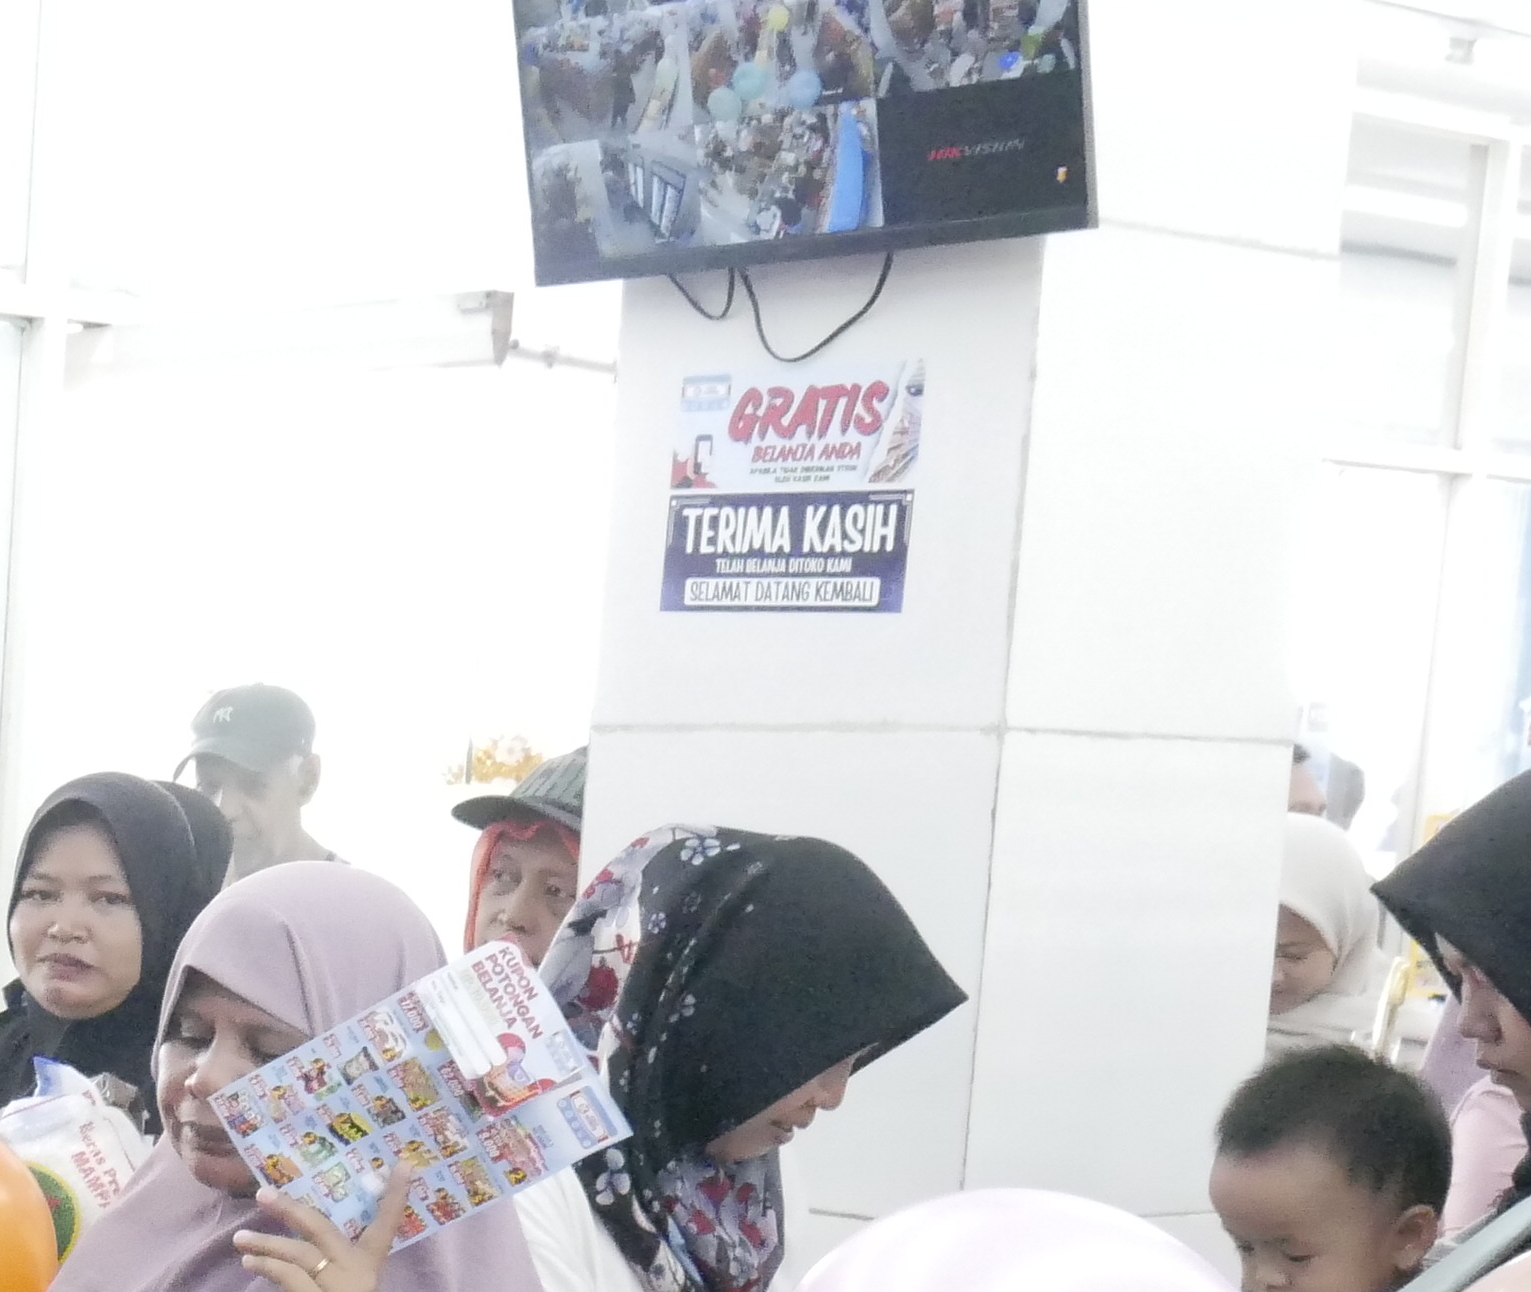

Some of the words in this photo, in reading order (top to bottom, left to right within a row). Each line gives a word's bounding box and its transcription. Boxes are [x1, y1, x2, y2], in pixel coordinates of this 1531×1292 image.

[728, 379, 890, 444] GRATIS
[751, 443, 815, 464] BELANJA
[818, 441, 862, 461] ANDA
[682, 505, 791, 554] TERIMA
[802, 503, 898, 553] KASIH
[690, 580, 750, 602] SELAMAT
[755, 580, 810, 602] DATANG
[815, 580, 874, 602] KEMBALI
[716, 558, 744, 573] TELAH
[746, 558, 786, 573] BELANJA
[789, 557, 825, 573] DITOKO
[827, 557, 852, 573] KAMI
[471, 960, 517, 1029] BELANJA
[485, 953, 543, 1039] POTONGAN
[498, 946, 539, 1001] KUPON
